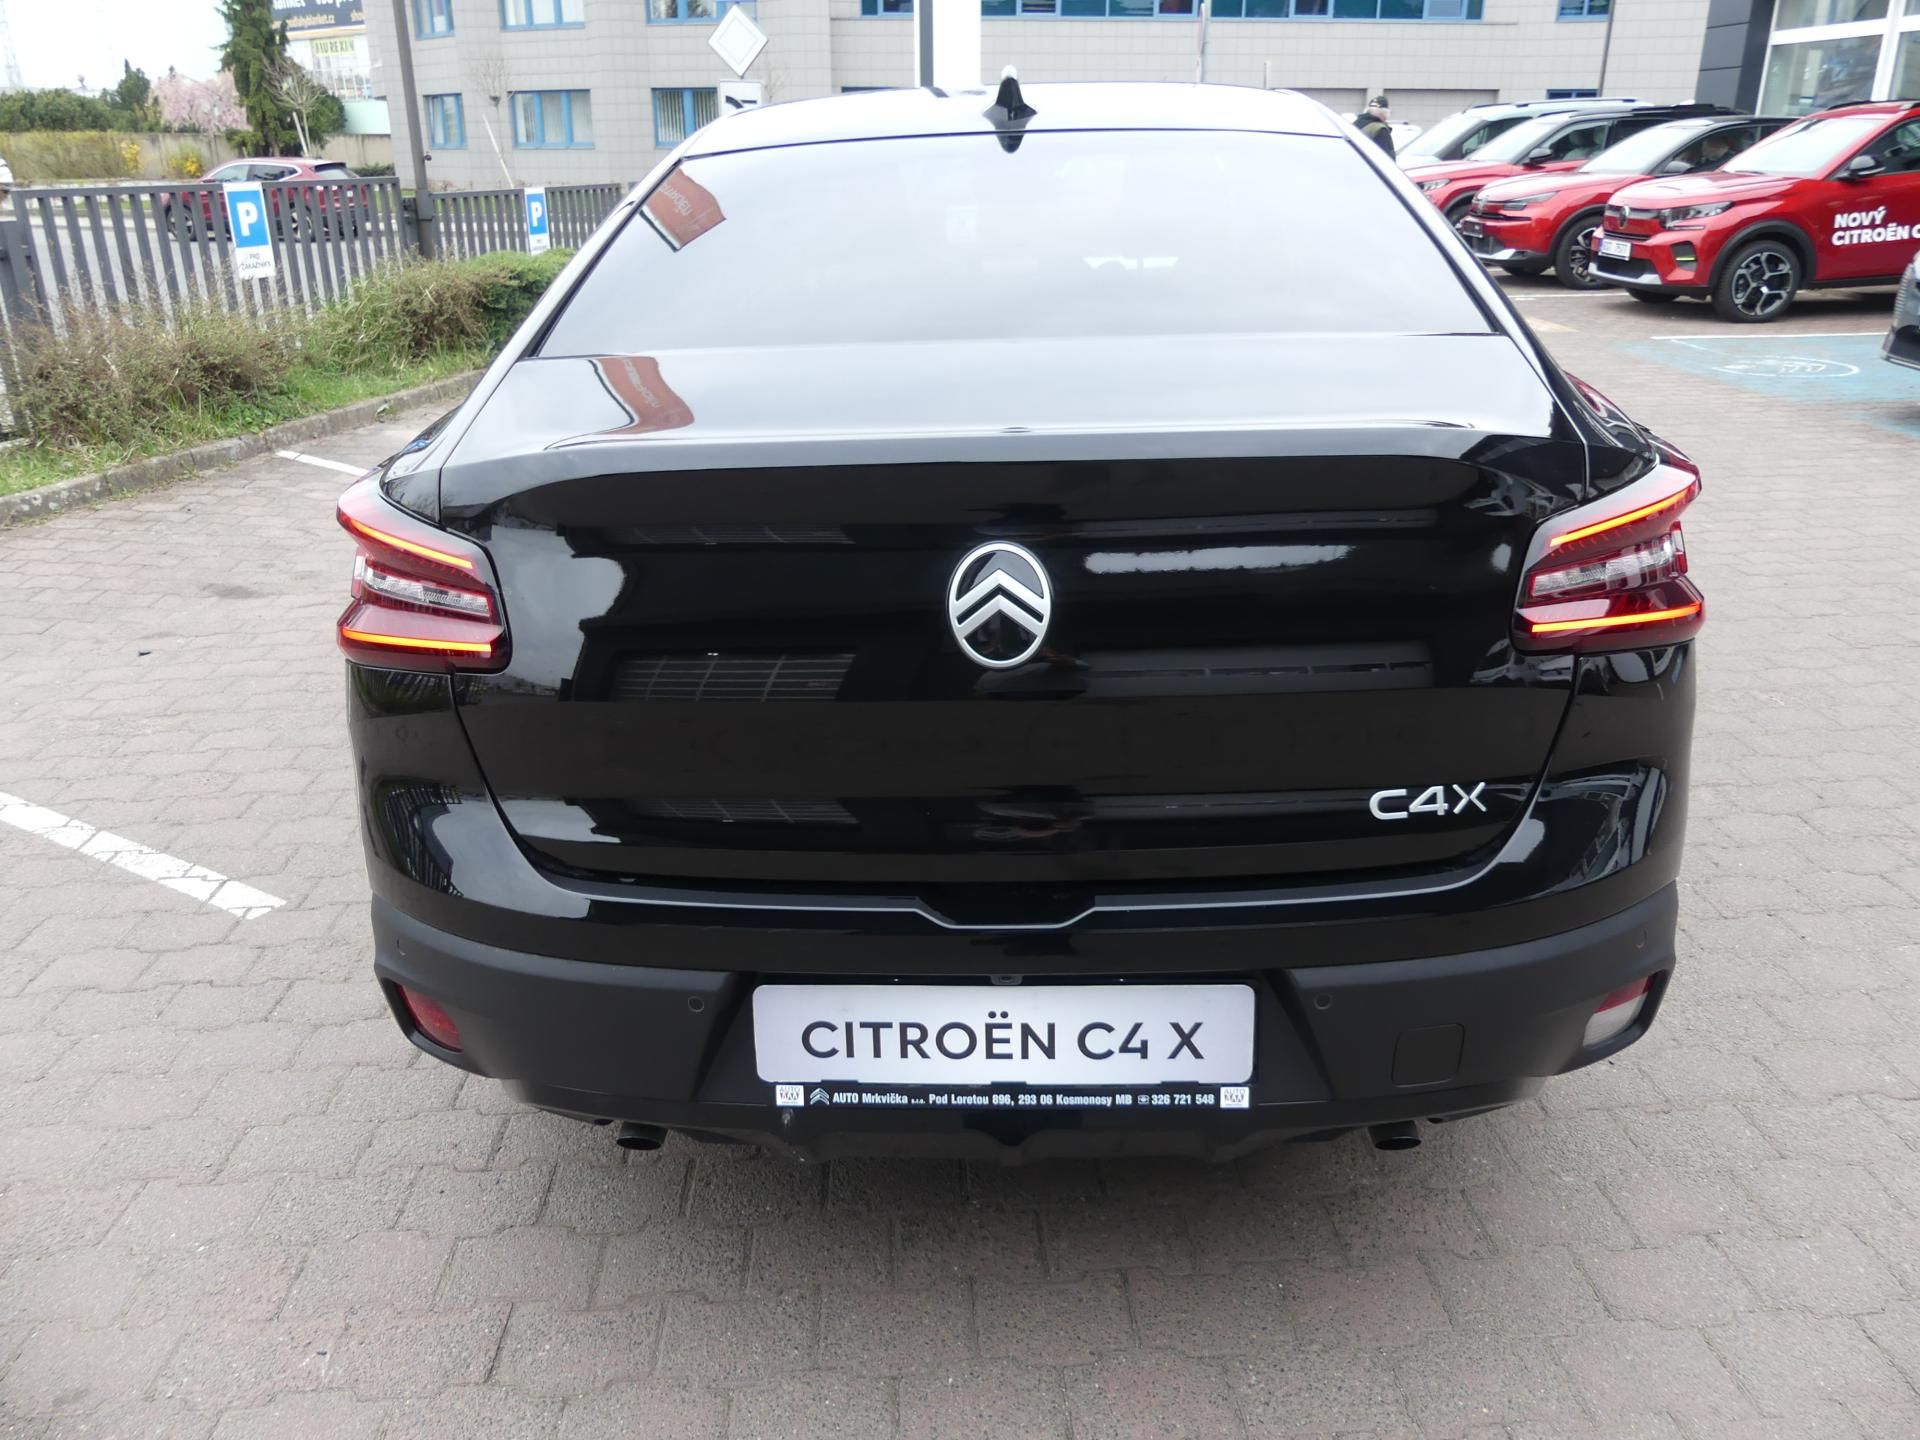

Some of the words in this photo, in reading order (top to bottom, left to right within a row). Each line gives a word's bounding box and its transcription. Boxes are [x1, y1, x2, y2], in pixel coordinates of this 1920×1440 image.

[236, 202, 258, 237] P
[531, 202, 542, 227] P
[1833, 206, 1887, 229] NOVÝ
[1831, 222, 1911, 246] CITROËN
[801, 1011, 1056, 1061] CITROËN
[1077, 1022, 1149, 1061] C4
[1167, 1022, 1205, 1060] X
[832, 1092, 859, 1104] AUTO
[862, 1092, 908, 1104] Mrkvička
[929, 1093, 948, 1105] Pod
[951, 1093, 989, 1105] Loretou
[992, 1093, 1014, 1106] 896,
[1018, 1093, 1037, 1105] 293
[1040, 1093, 1053, 1105] 06
[1056, 1093, 1112, 1107] Kosmonosy
[1115, 1094, 1132, 1105] MB
[1151, 1094, 1170, 1105] 326
[1174, 1094, 1191, 1105] 721
[1195, 1094, 1214, 1105] 548
